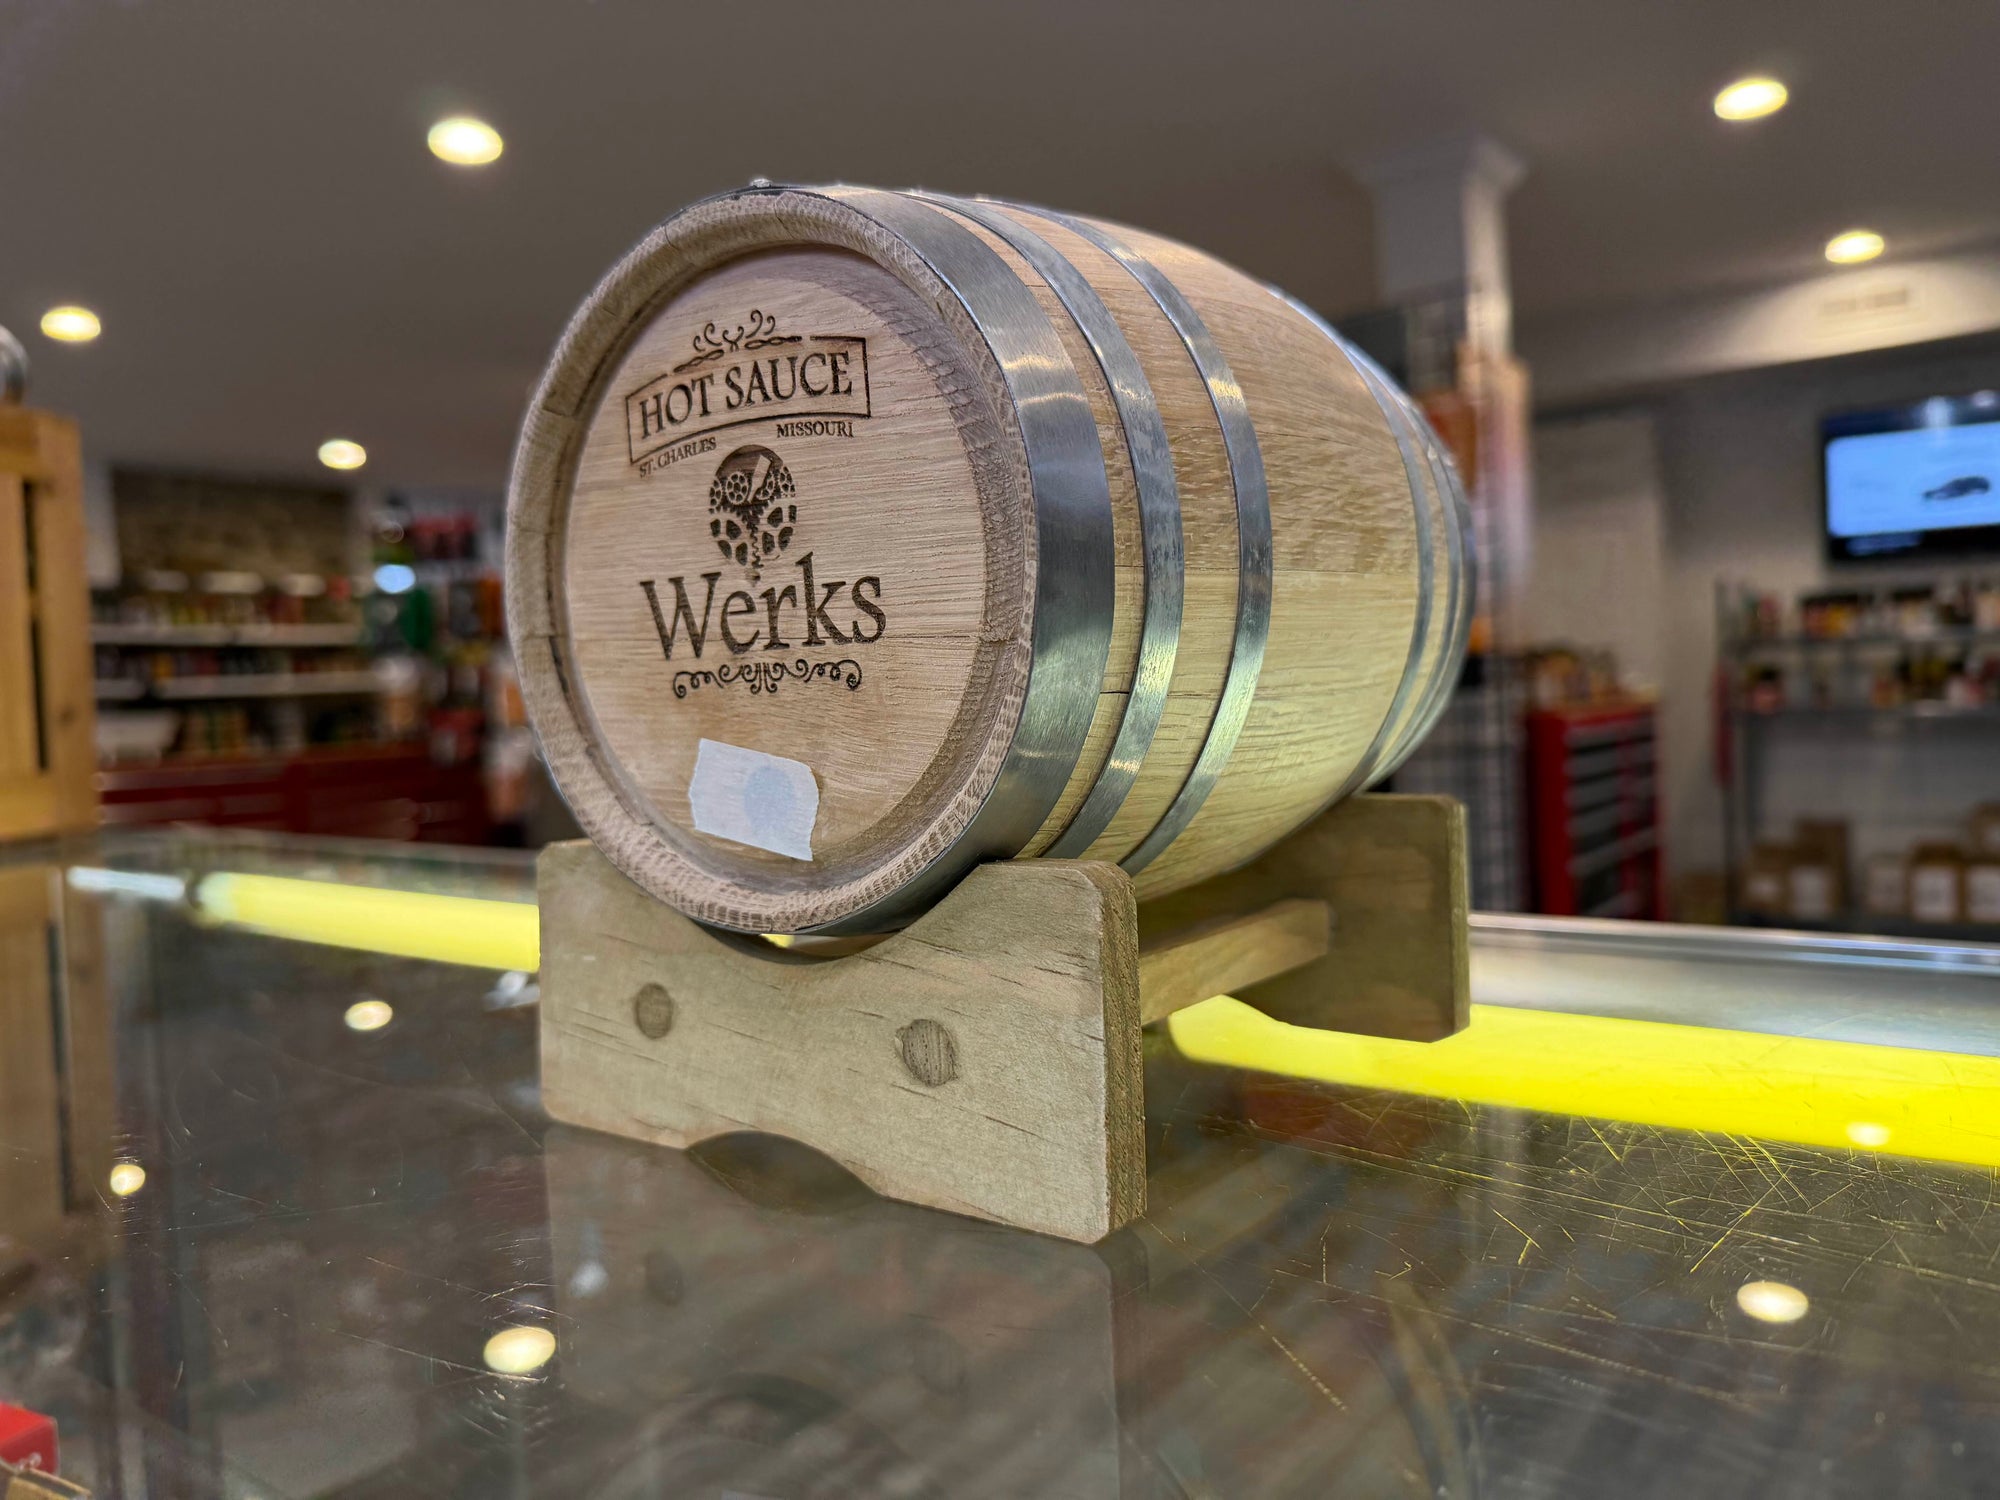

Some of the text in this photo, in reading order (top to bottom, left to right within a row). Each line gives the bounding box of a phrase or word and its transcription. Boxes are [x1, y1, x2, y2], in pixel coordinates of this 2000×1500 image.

[640, 350, 853, 439] HOT SAUCE
[640, 420, 854, 478] ST. CHARLES MISSOURI
[639, 551, 887, 660] Werks
